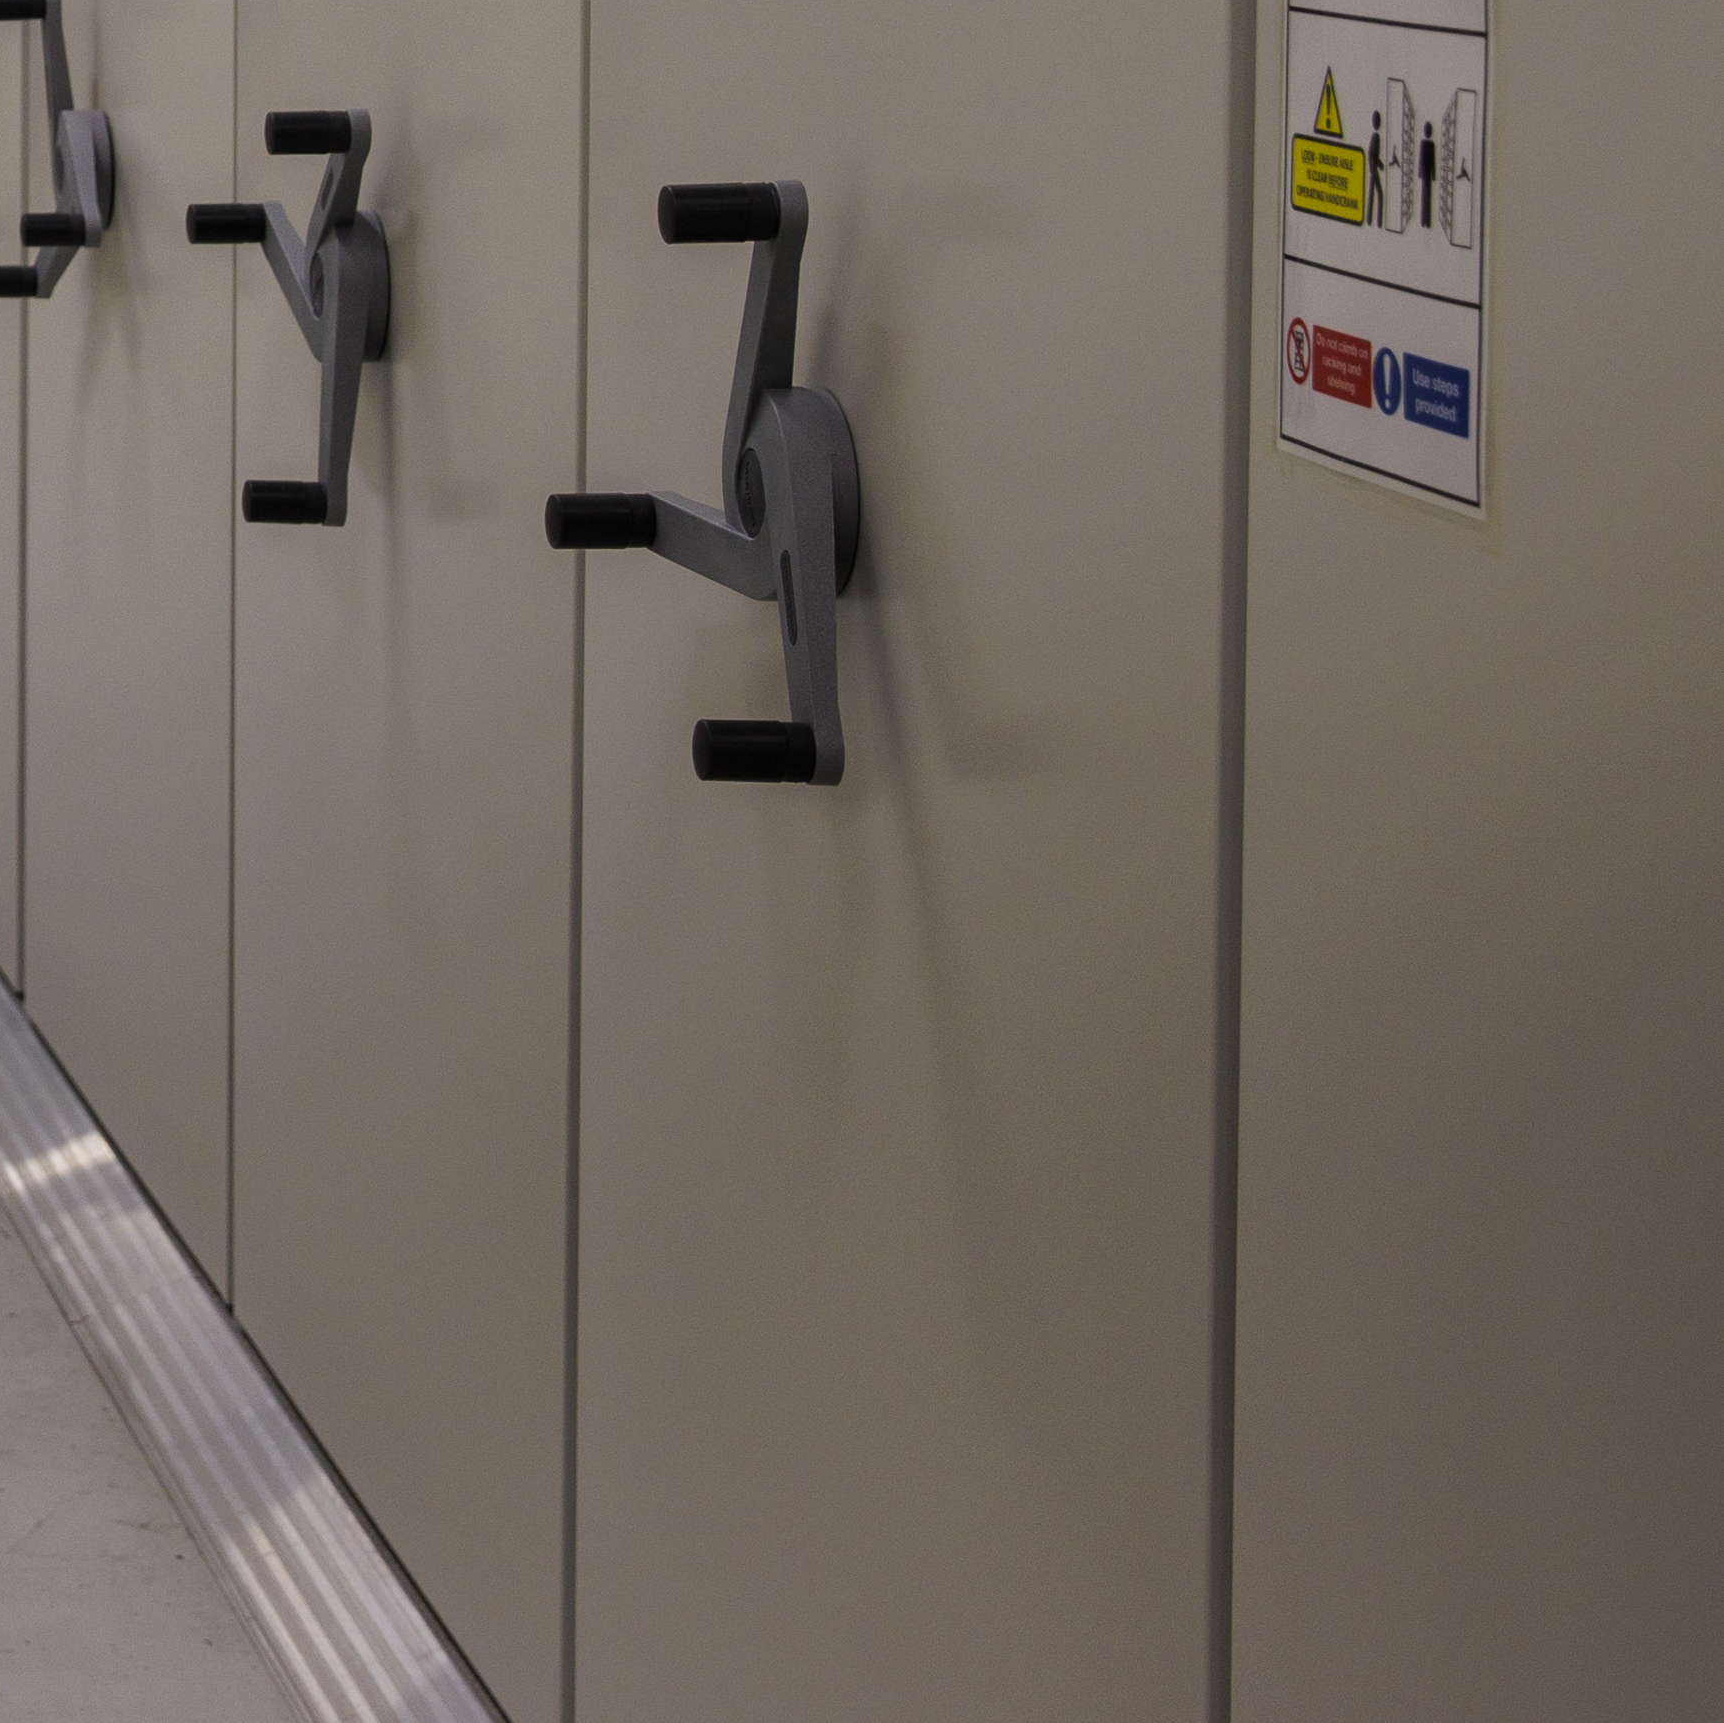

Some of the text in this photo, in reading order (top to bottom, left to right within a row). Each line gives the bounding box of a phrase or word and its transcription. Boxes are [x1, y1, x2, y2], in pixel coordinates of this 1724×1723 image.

[1316, 332, 1369, 359] Do not climb on
[1322, 355, 1361, 376] racking and
[1412, 368, 1459, 398] Use steps
[1415, 398, 1456, 423] provided
